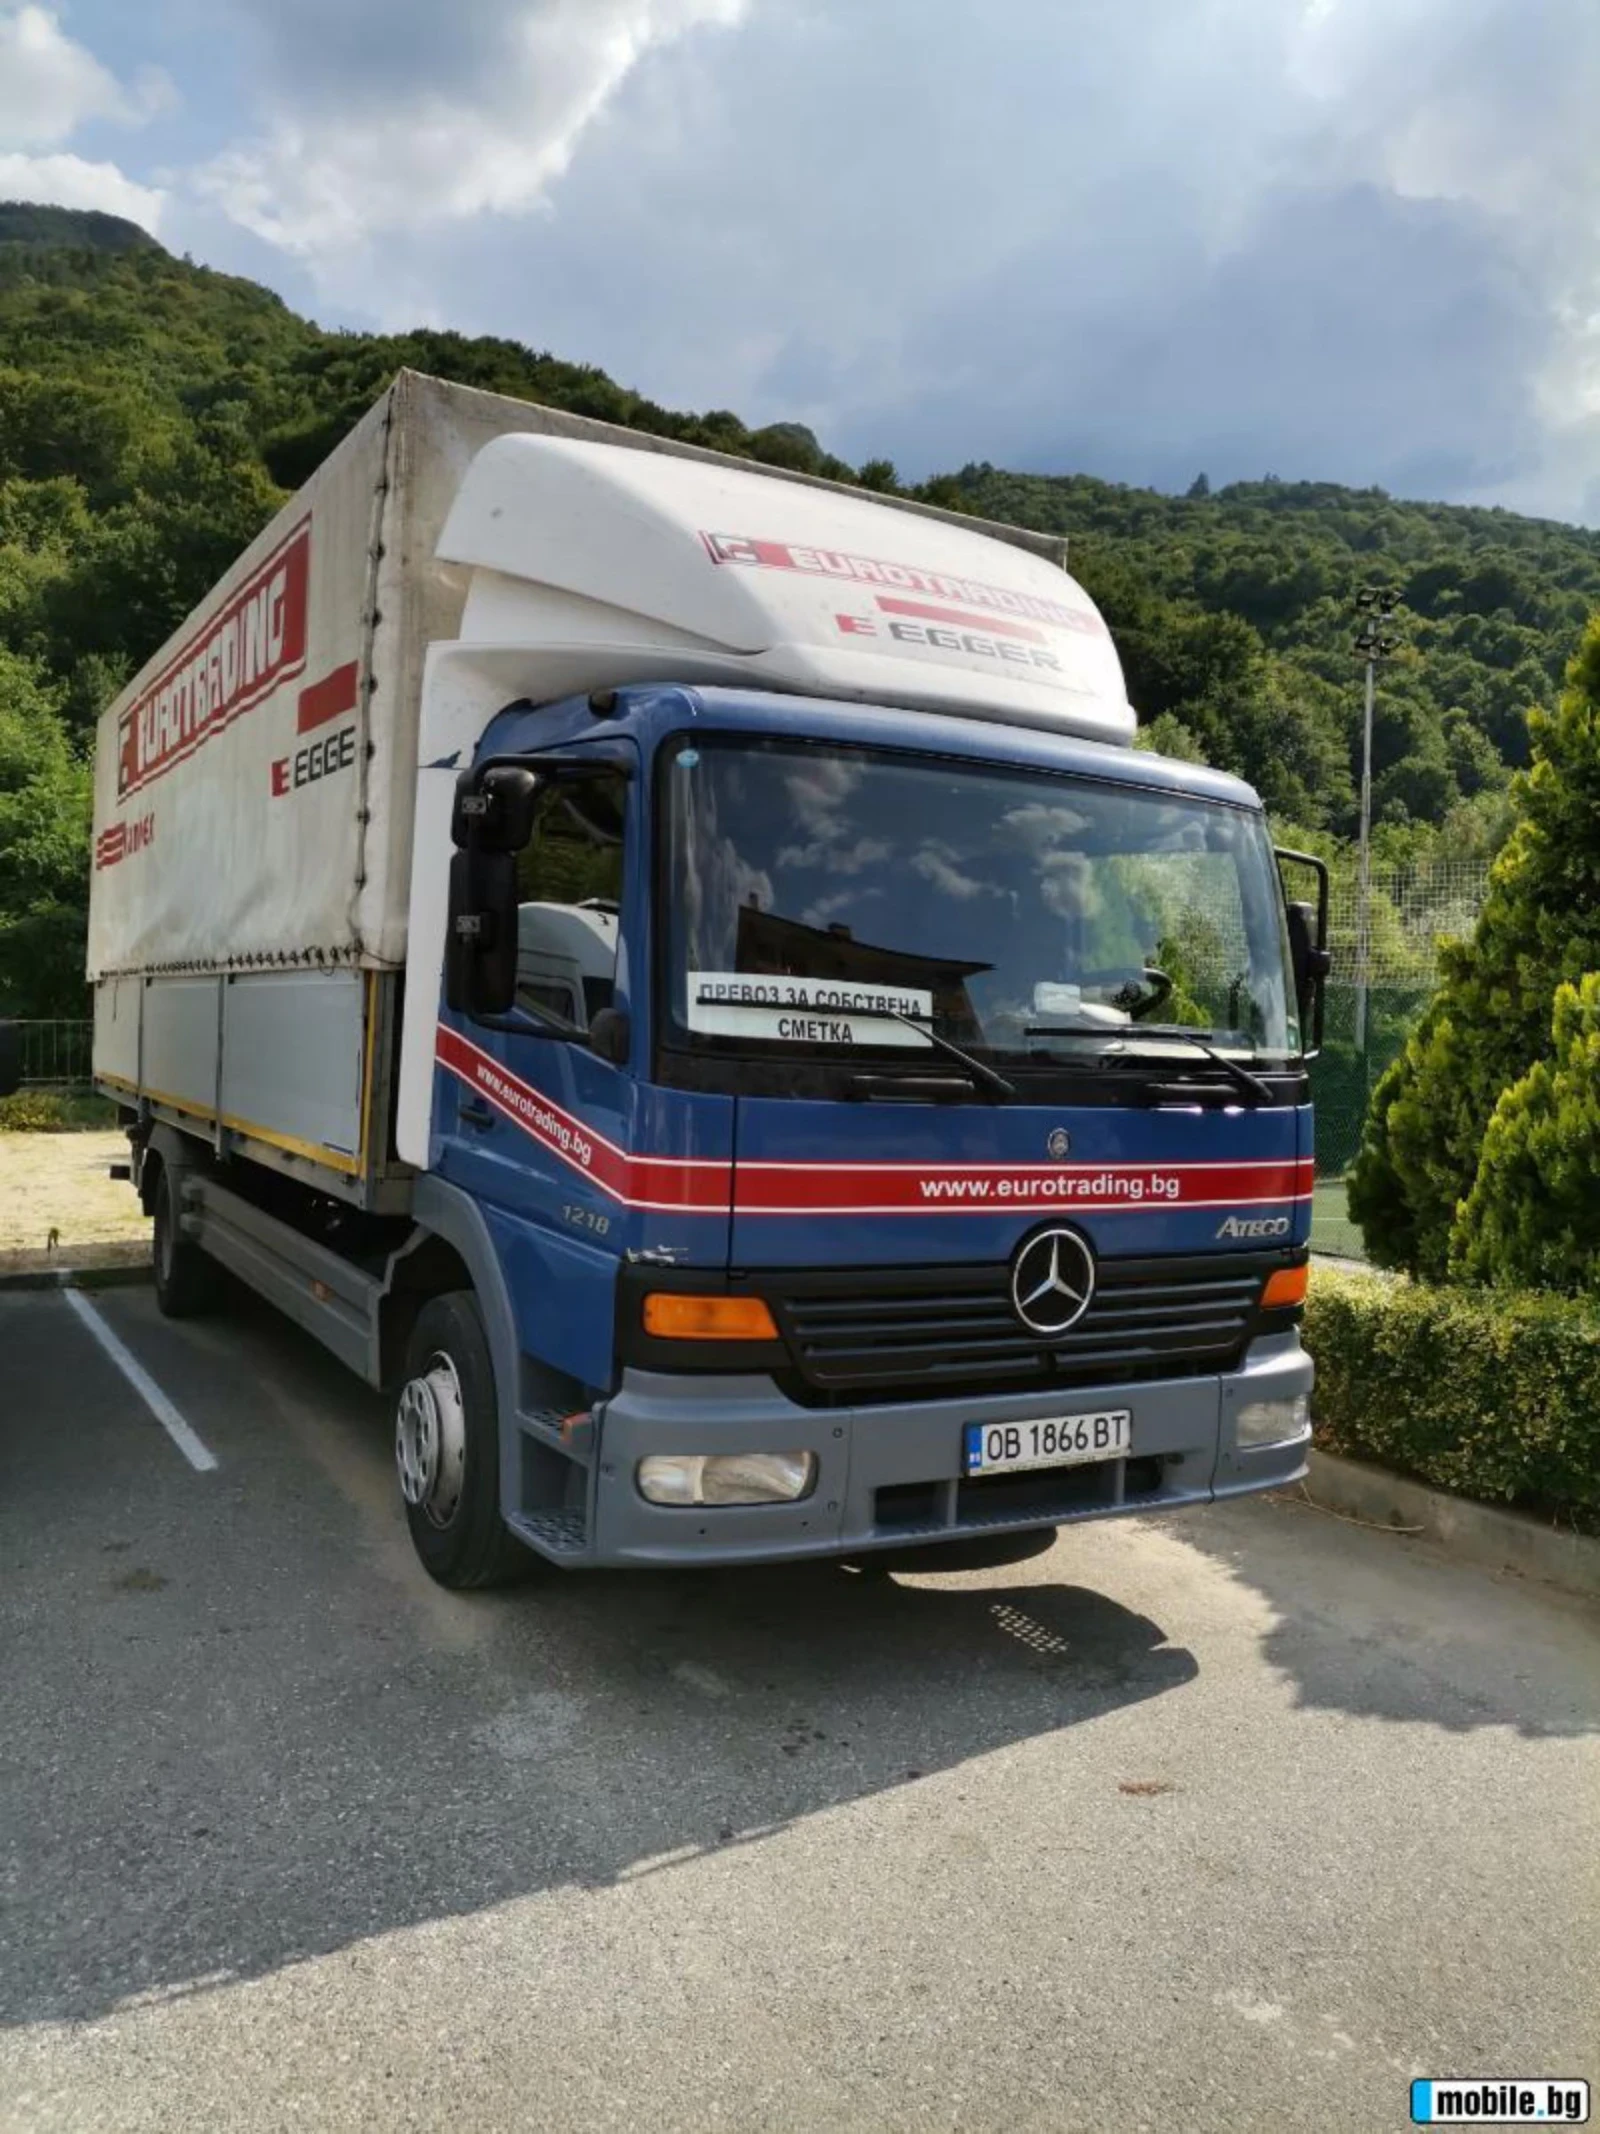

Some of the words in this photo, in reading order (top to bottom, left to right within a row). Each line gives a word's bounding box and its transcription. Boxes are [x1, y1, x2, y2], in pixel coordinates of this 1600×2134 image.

[888, 621, 1066, 672] EGGER
[700, 983, 779, 1005] ПРЕВОЗ
[786, 987, 809, 1009] ЗА
[815, 989, 922, 1017] СОБСТВЕНА
[778, 1018, 853, 1043] СМЕТКА
[477, 1062, 592, 1166] www.eurotrading.bg
[920, 1173, 1181, 1200] www.eurotrading.bg
[562, 1205, 611, 1236] 1218
[987, 1427, 1021, 1461] OB
